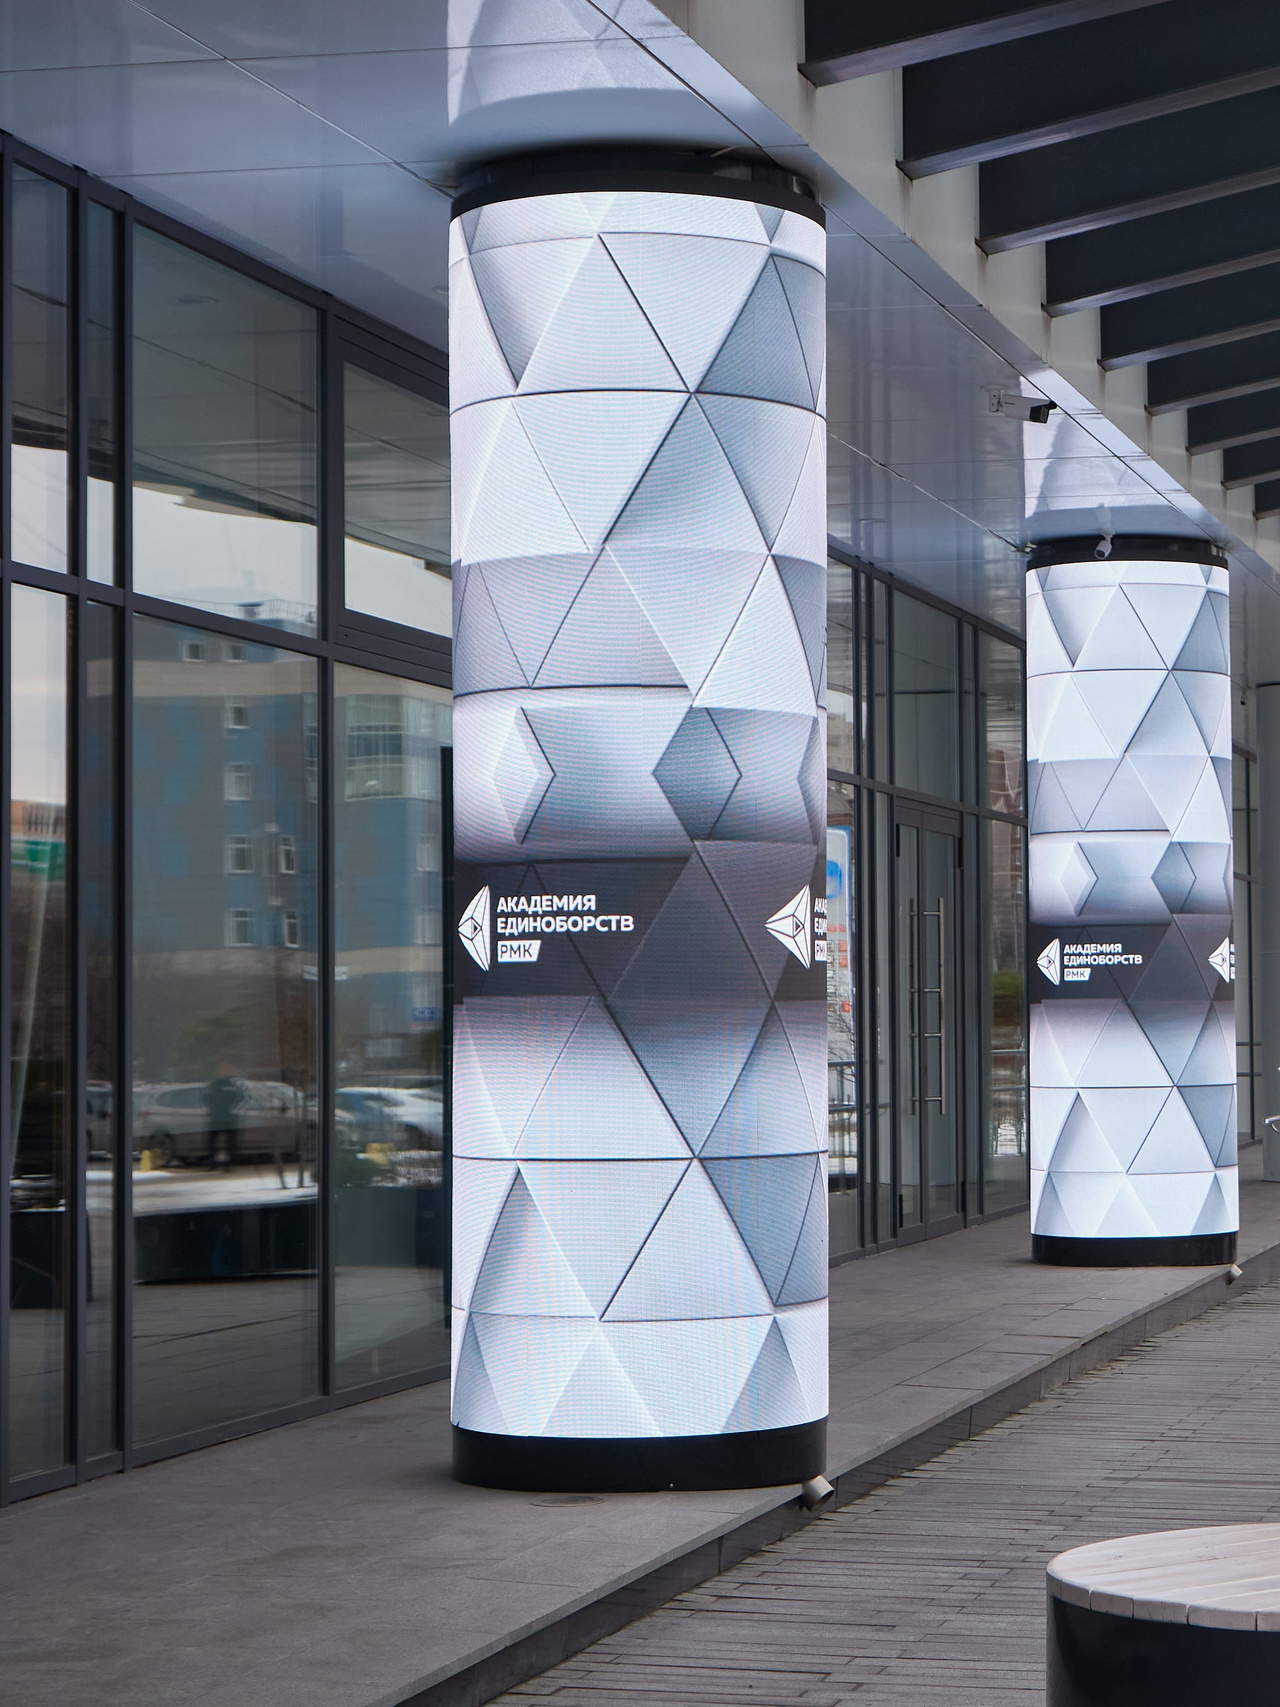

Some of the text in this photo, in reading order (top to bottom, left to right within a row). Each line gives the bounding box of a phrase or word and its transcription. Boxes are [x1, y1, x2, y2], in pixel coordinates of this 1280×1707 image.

[497, 895, 596, 914] АКАДЕМИЯ
[497, 915, 634, 936] ЕДИНОБОРСТВ
[500, 943, 533, 959] РМК
[1063, 944, 1122, 955] АКАДЕМИЯ
[1063, 955, 1143, 967] ЕДИНОБОРСТВ
[1065, 970, 1086, 979] РМК
